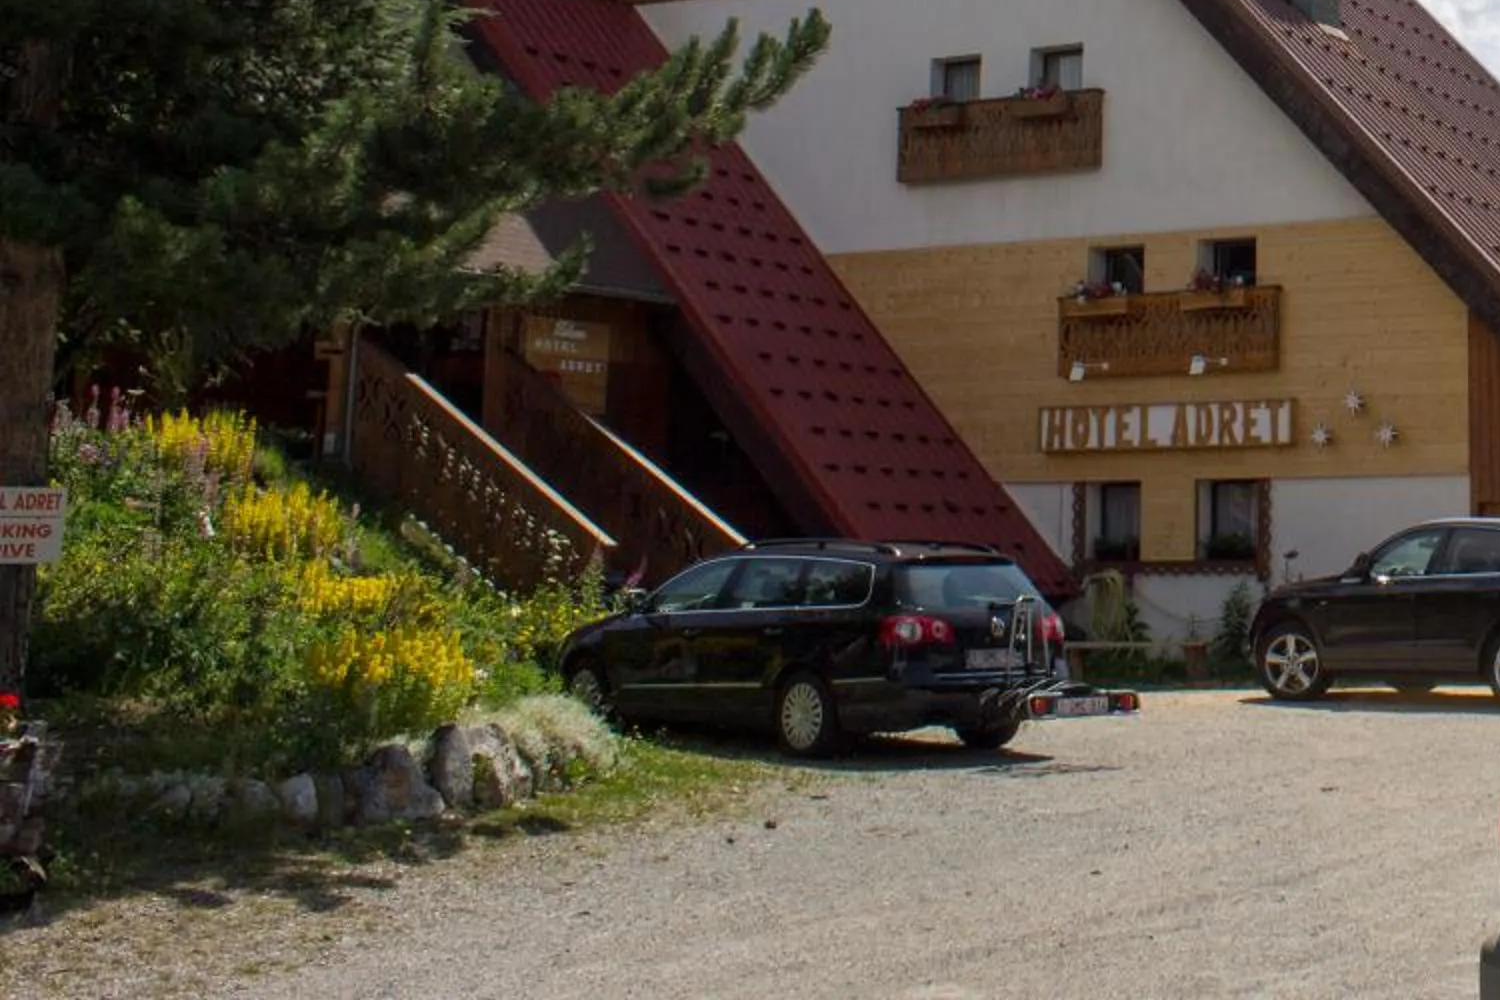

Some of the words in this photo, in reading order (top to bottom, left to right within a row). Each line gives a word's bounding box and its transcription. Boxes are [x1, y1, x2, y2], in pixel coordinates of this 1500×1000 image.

[1046, 407, 1158, 450] HOTEL
[1172, 402, 1286, 446] ADRET
[14, 493, 63, 511] ADRET
[0, 543, 35, 558] IVE
